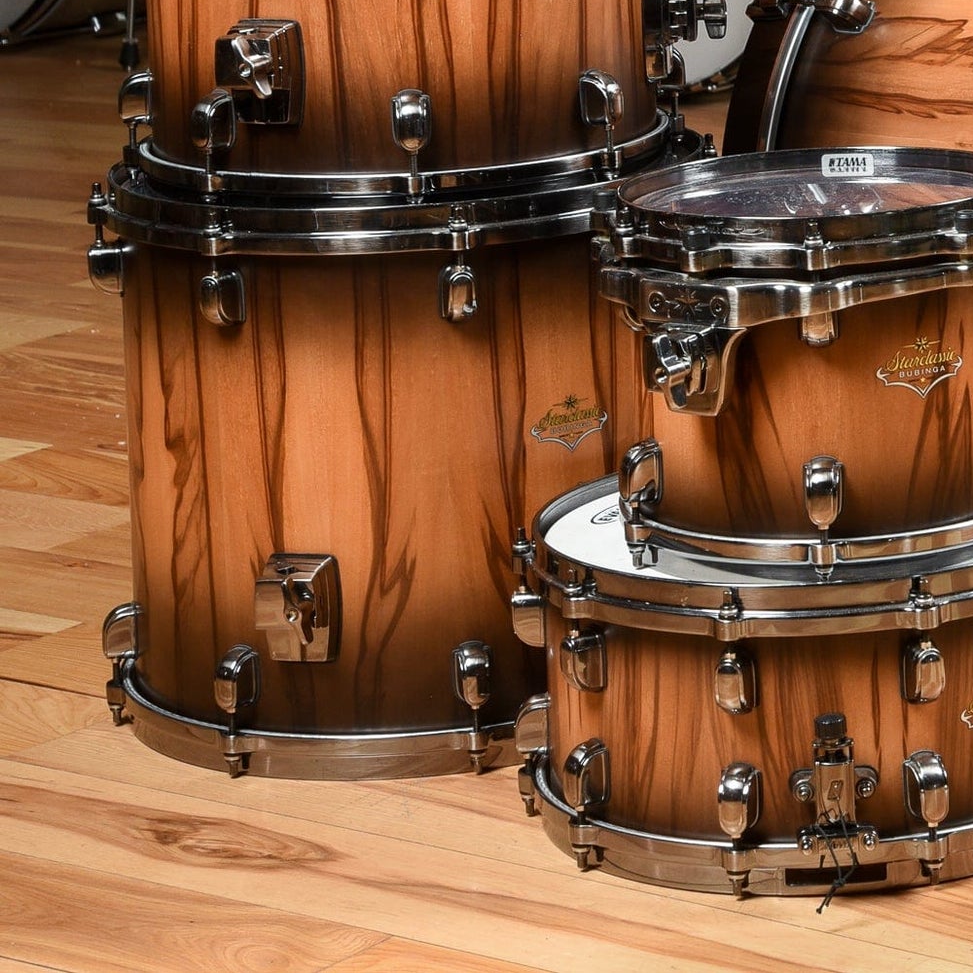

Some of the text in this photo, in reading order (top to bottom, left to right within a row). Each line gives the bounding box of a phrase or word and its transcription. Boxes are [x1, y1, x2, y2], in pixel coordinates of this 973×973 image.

[836, 157, 867, 167] TAMA
[884, 347, 956, 372] Starclassic
[899, 365, 946, 378] BUBINGA
